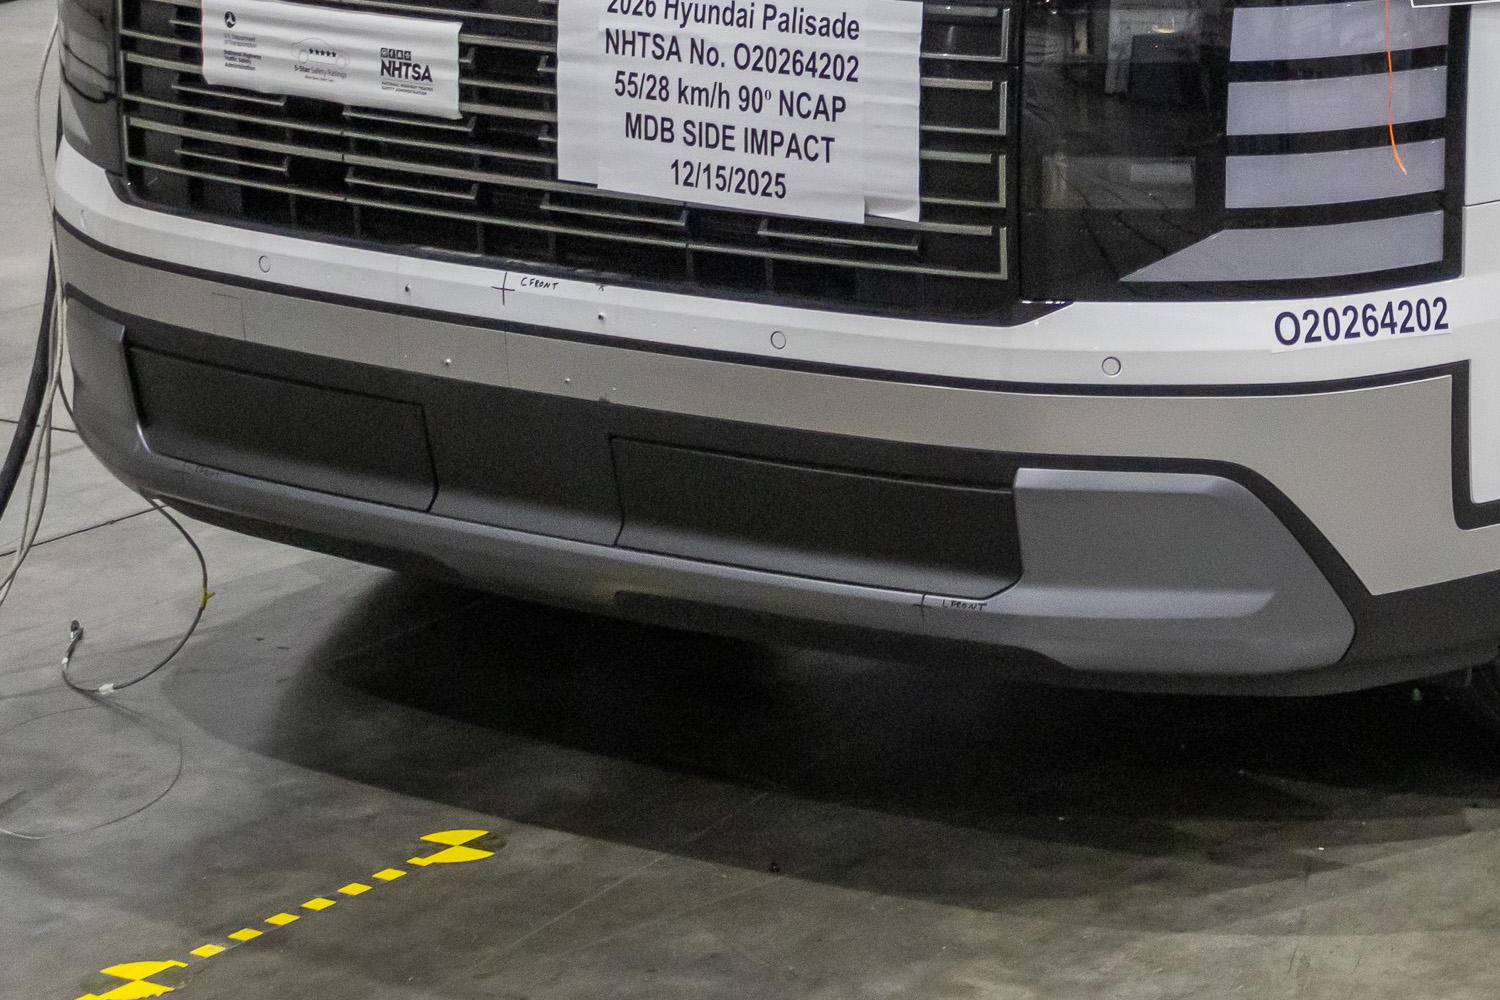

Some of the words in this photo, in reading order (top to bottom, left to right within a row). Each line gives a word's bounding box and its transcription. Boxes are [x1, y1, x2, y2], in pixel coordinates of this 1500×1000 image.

[762, 3, 860, 40] Palisade
[380, 59, 433, 83] NHTSA
[605, 28, 681, 62] NHTSA
[690, 37, 725, 68] No.
[734, 43, 859, 83] O20264202
[615, 70, 670, 102] 55/28
[678, 77, 730, 110] km/h
[779, 90, 847, 123] NCAP
[625, 112, 675, 144] MDB
[683, 120, 736, 152] SIDE
[744, 127, 836, 164] IMPACT
[671, 159, 787, 200] 12/15/2025
[1274, 296, 1449, 346] O20264202
